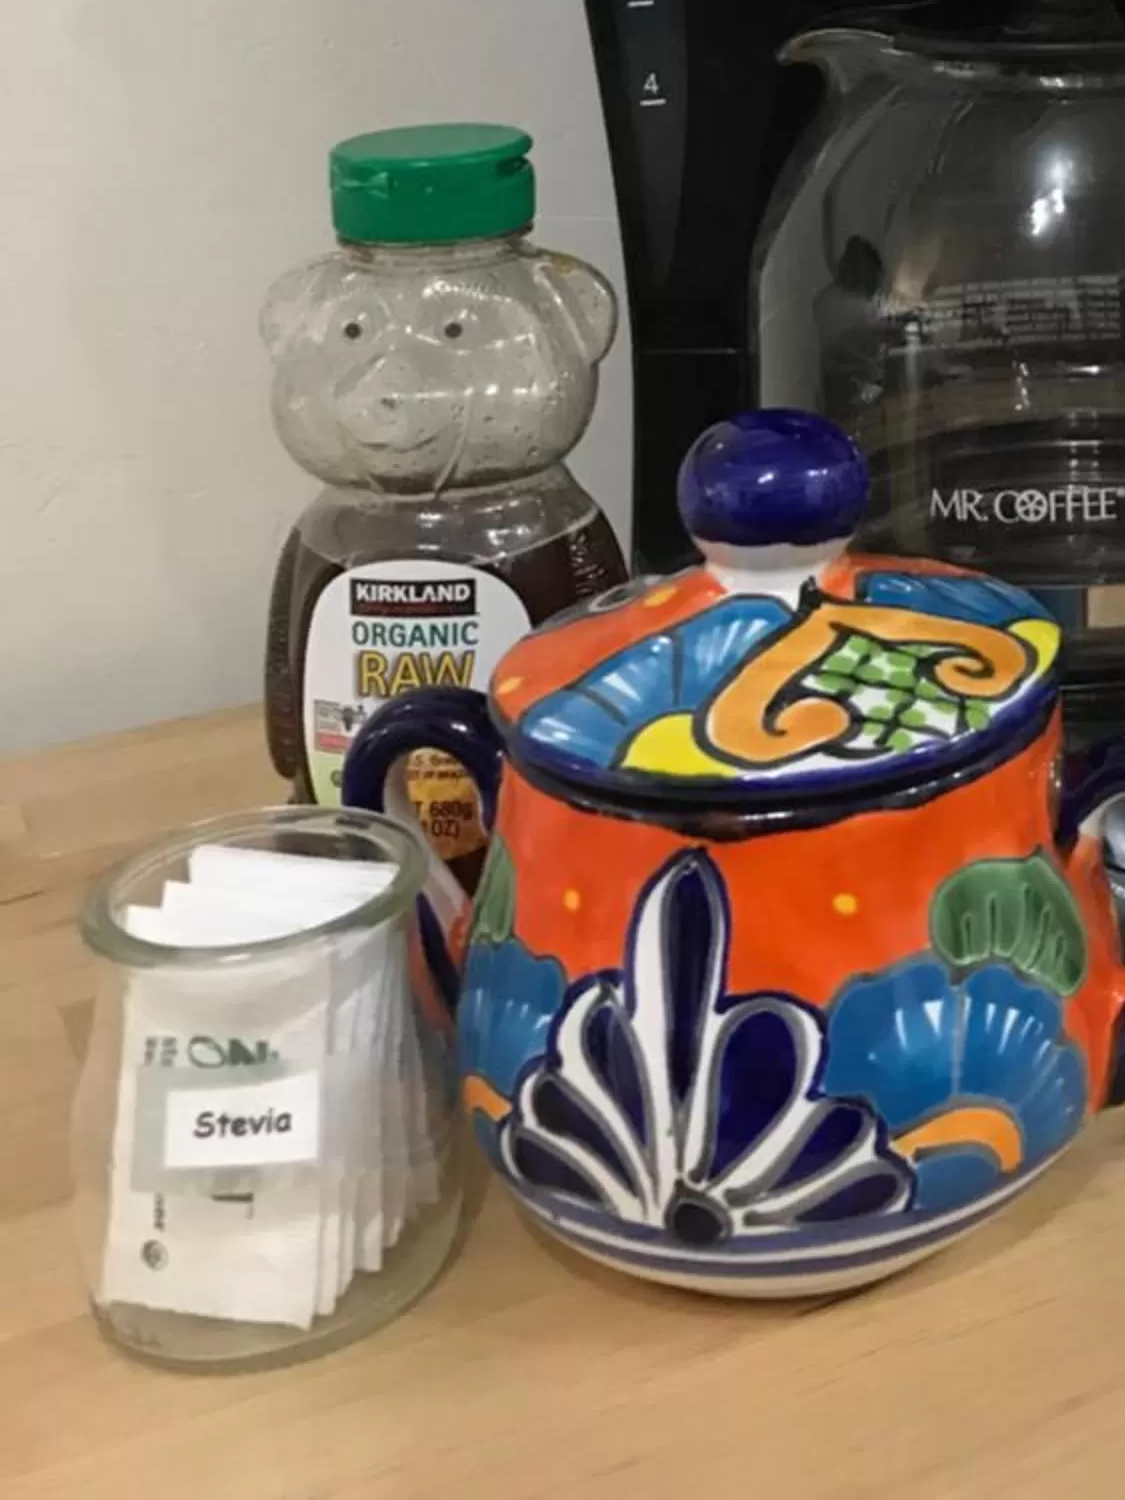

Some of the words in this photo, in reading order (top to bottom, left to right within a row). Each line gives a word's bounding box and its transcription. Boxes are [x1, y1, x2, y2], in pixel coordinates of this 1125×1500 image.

[643, 73, 659, 94] 4
[355, 584, 472, 603] KIRKLAND
[352, 621, 479, 648] ORGANIC
[356, 650, 477, 699] RAW
[194, 1105, 293, 1140] Stevia
